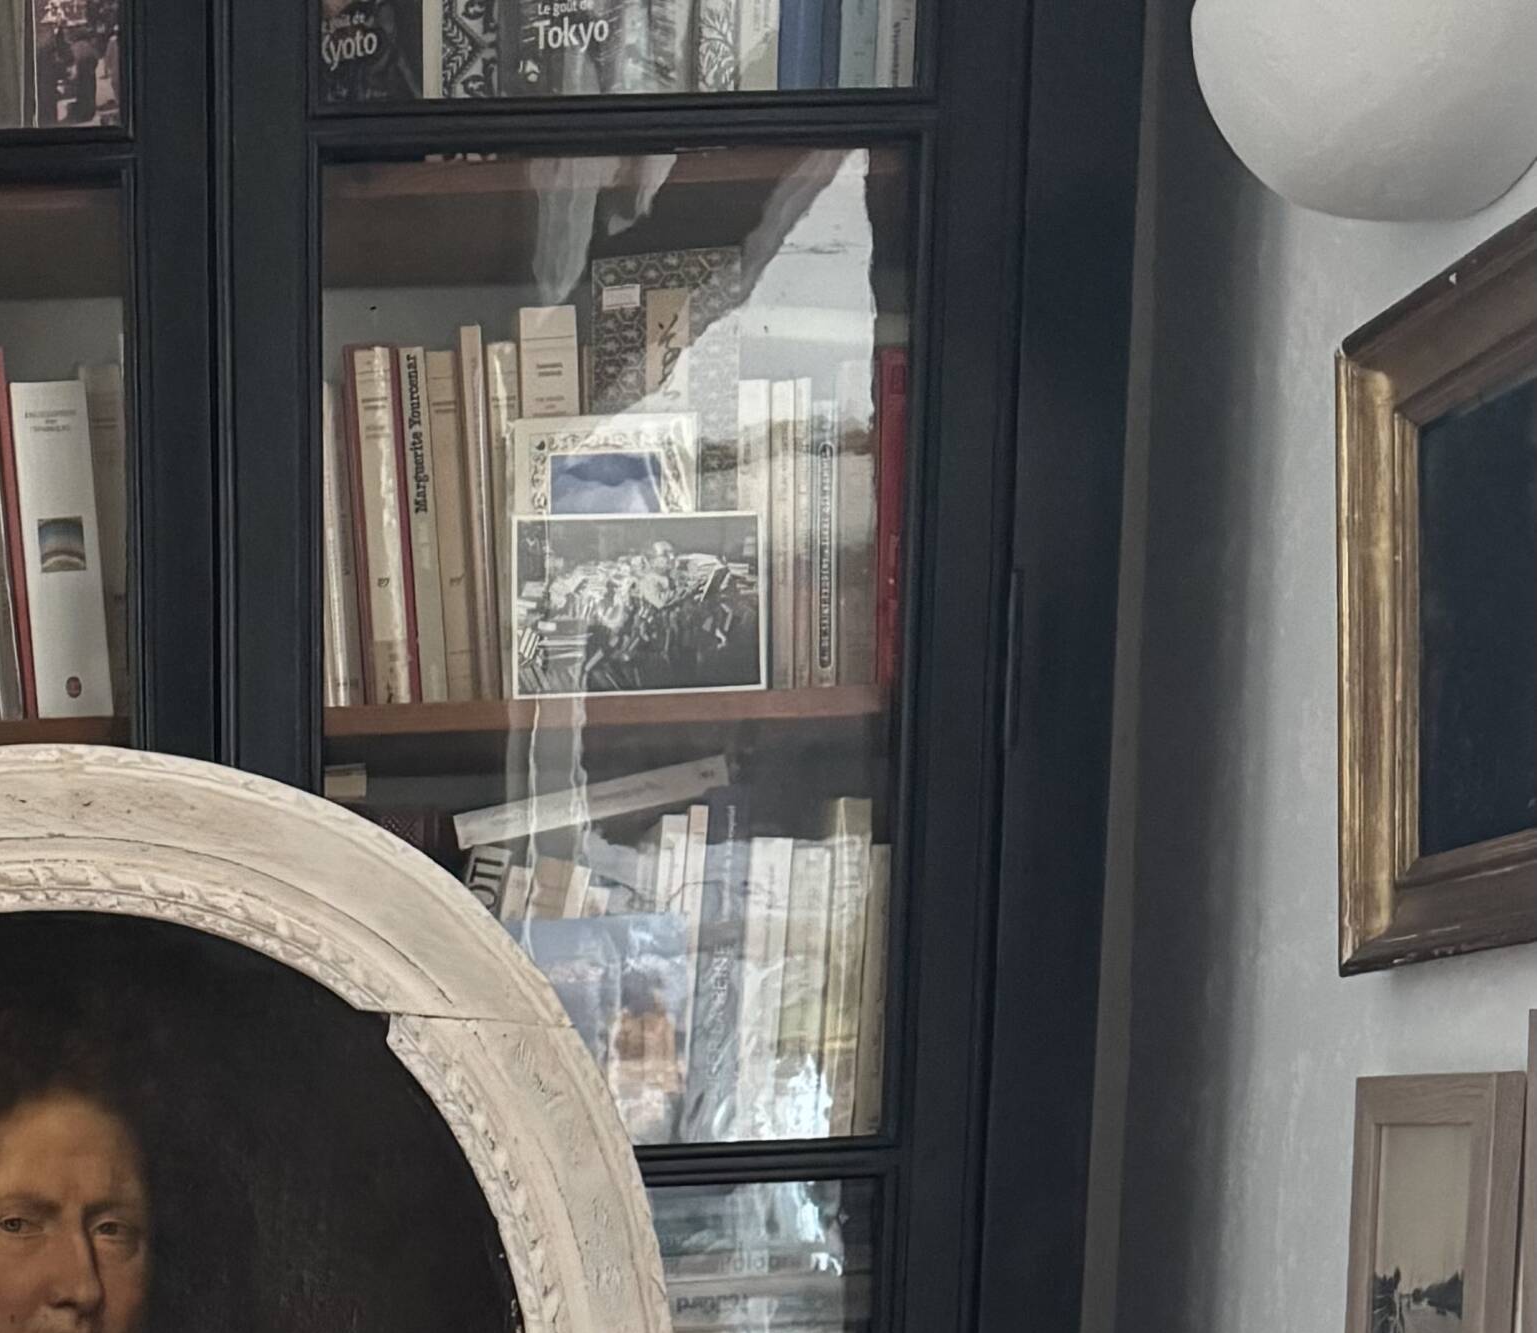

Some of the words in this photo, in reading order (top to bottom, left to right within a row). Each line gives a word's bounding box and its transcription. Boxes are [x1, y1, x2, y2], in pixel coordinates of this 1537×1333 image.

[533, 16, 609, 53] Tokyo
[406, 354, 425, 430] Yourcenar
[409, 431, 429, 514] Marguerite
